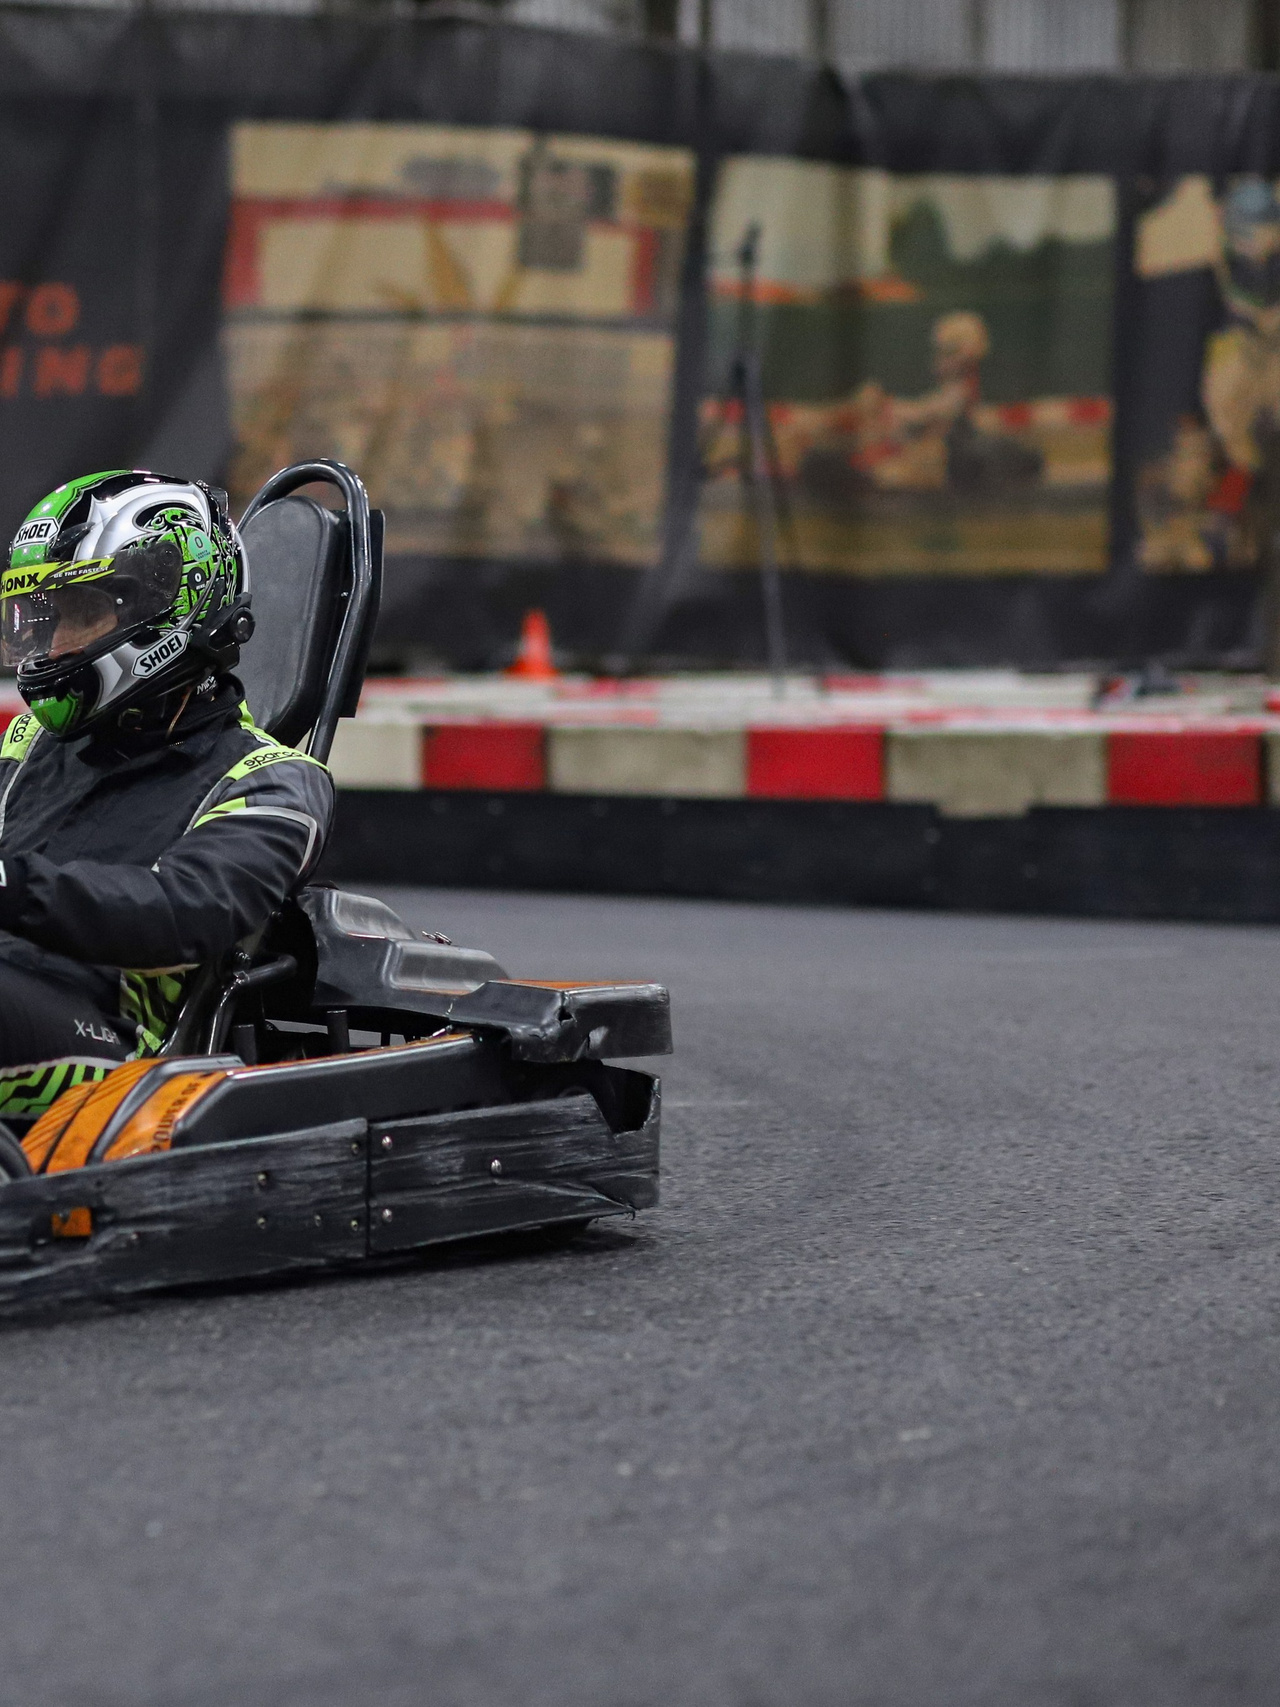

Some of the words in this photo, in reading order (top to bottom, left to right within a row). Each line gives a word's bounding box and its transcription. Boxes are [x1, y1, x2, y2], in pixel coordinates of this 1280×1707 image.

[16, 523, 51, 543] SHOEI
[78, 566, 109, 575] FASTEST
[140, 635, 182, 673] SHOEI
